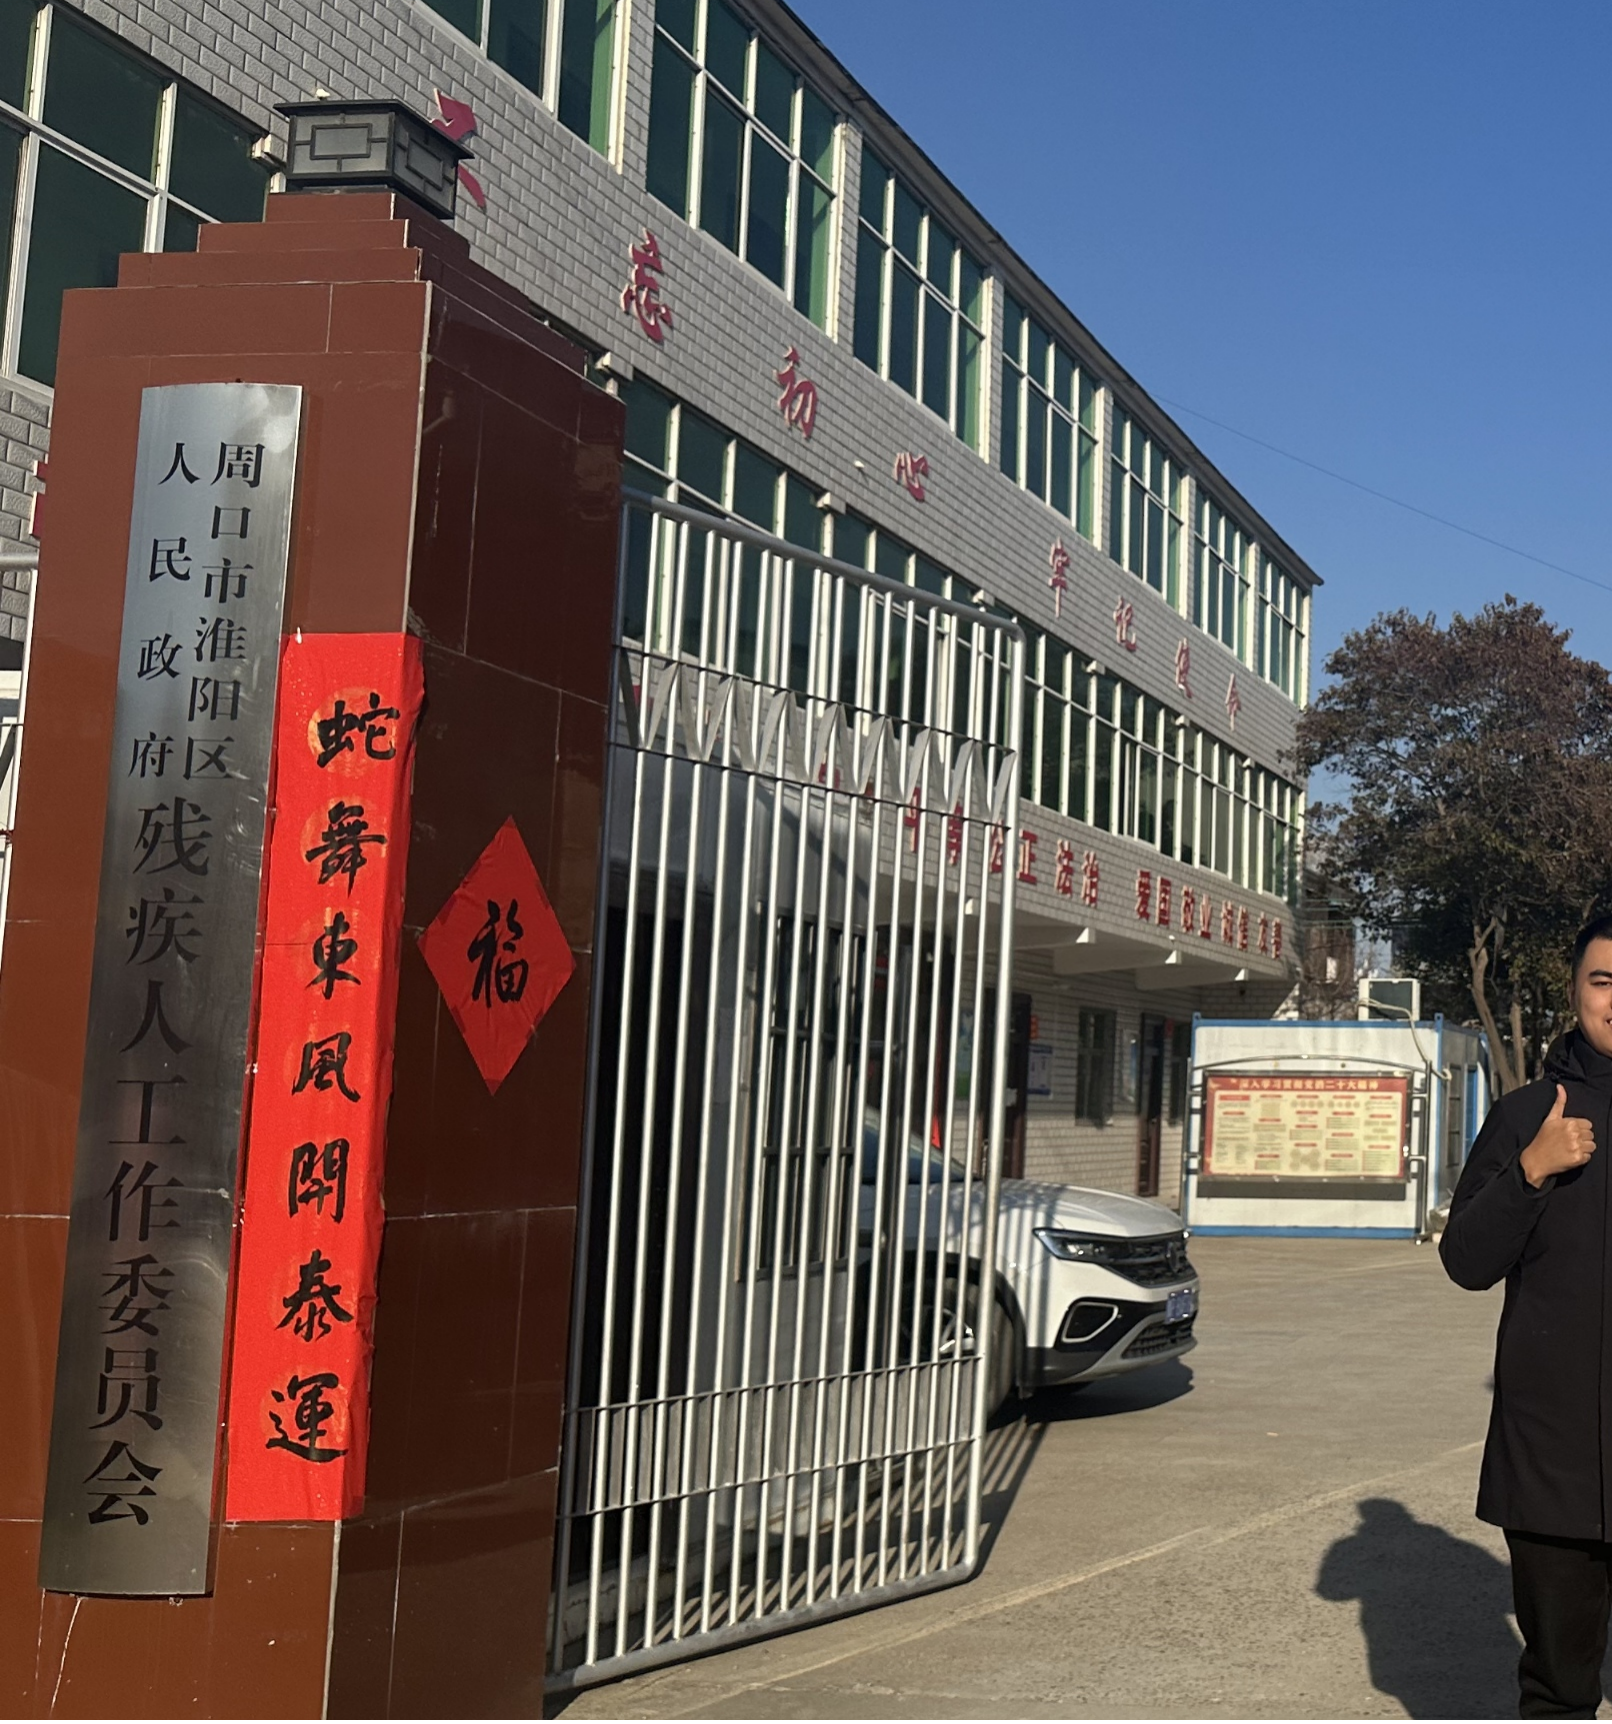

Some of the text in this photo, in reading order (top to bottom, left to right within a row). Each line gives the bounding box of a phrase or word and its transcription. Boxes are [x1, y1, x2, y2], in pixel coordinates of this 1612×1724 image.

[127, 441, 200, 778] 人民政府
[182, 442, 266, 782] 周口市淮阳区
[265, 692, 400, 1464] 蛇舞東風開泰運
[467, 897, 530, 1009] 福
[82, 796, 212, 1527] 残疾人工作委员会
